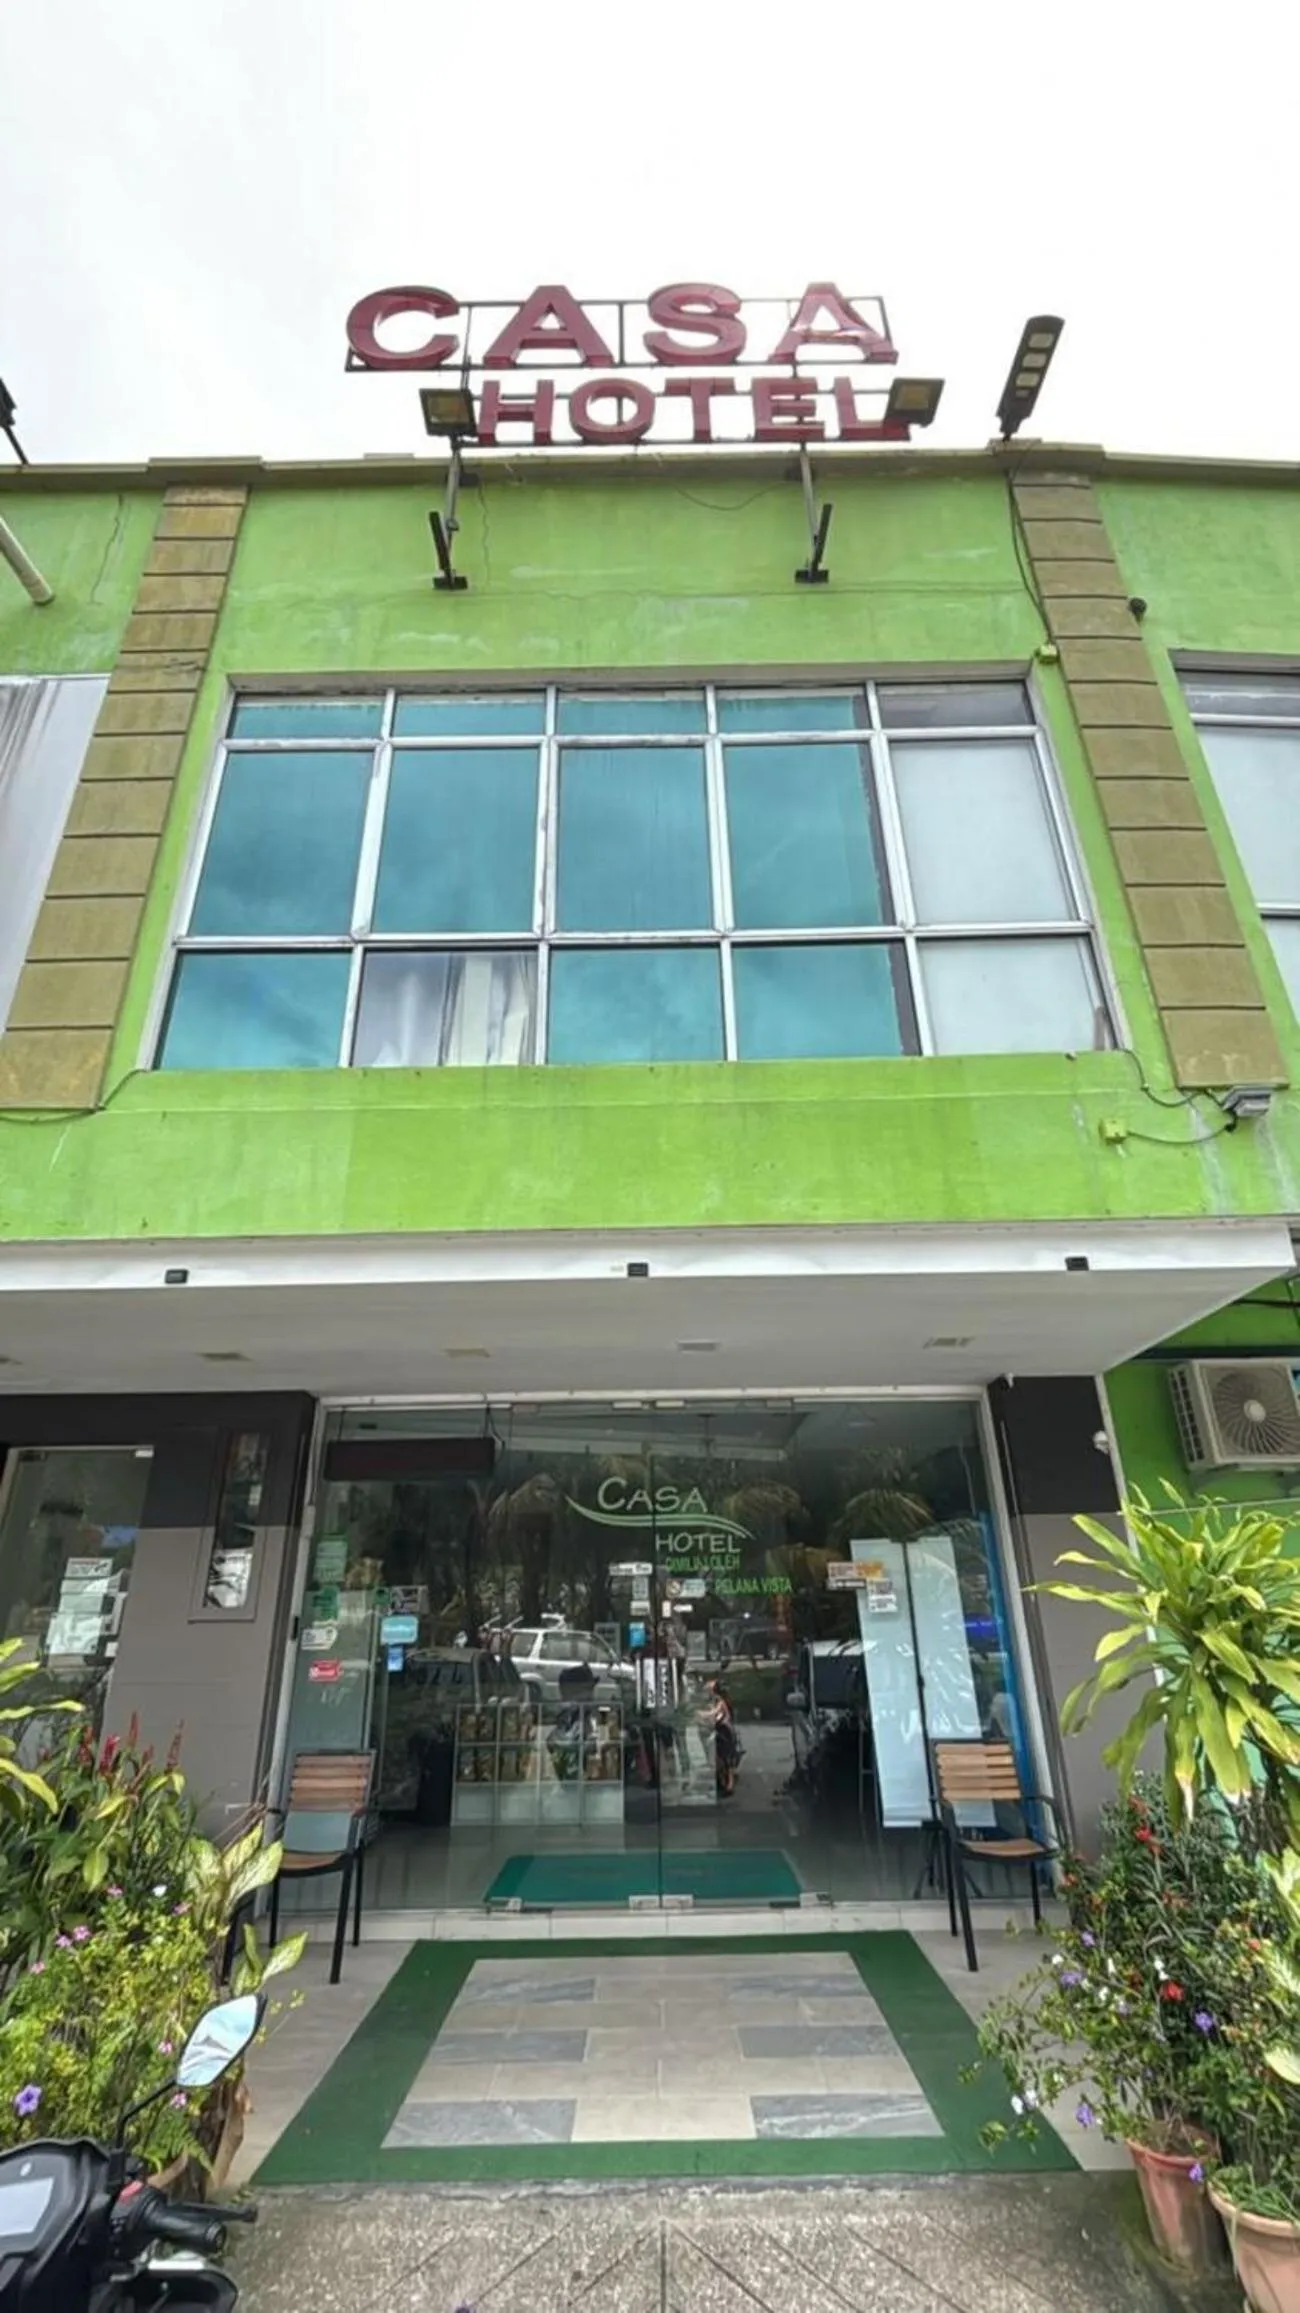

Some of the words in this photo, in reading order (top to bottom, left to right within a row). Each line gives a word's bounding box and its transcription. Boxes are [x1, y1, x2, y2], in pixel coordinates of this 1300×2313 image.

[347, 283, 898, 369] CASA
[477, 376, 911, 444] HOTEL
[598, 1477, 708, 1513] CASA
[655, 1532, 741, 1553] HOTEL
[761, 1576, 793, 1593] VISTA
